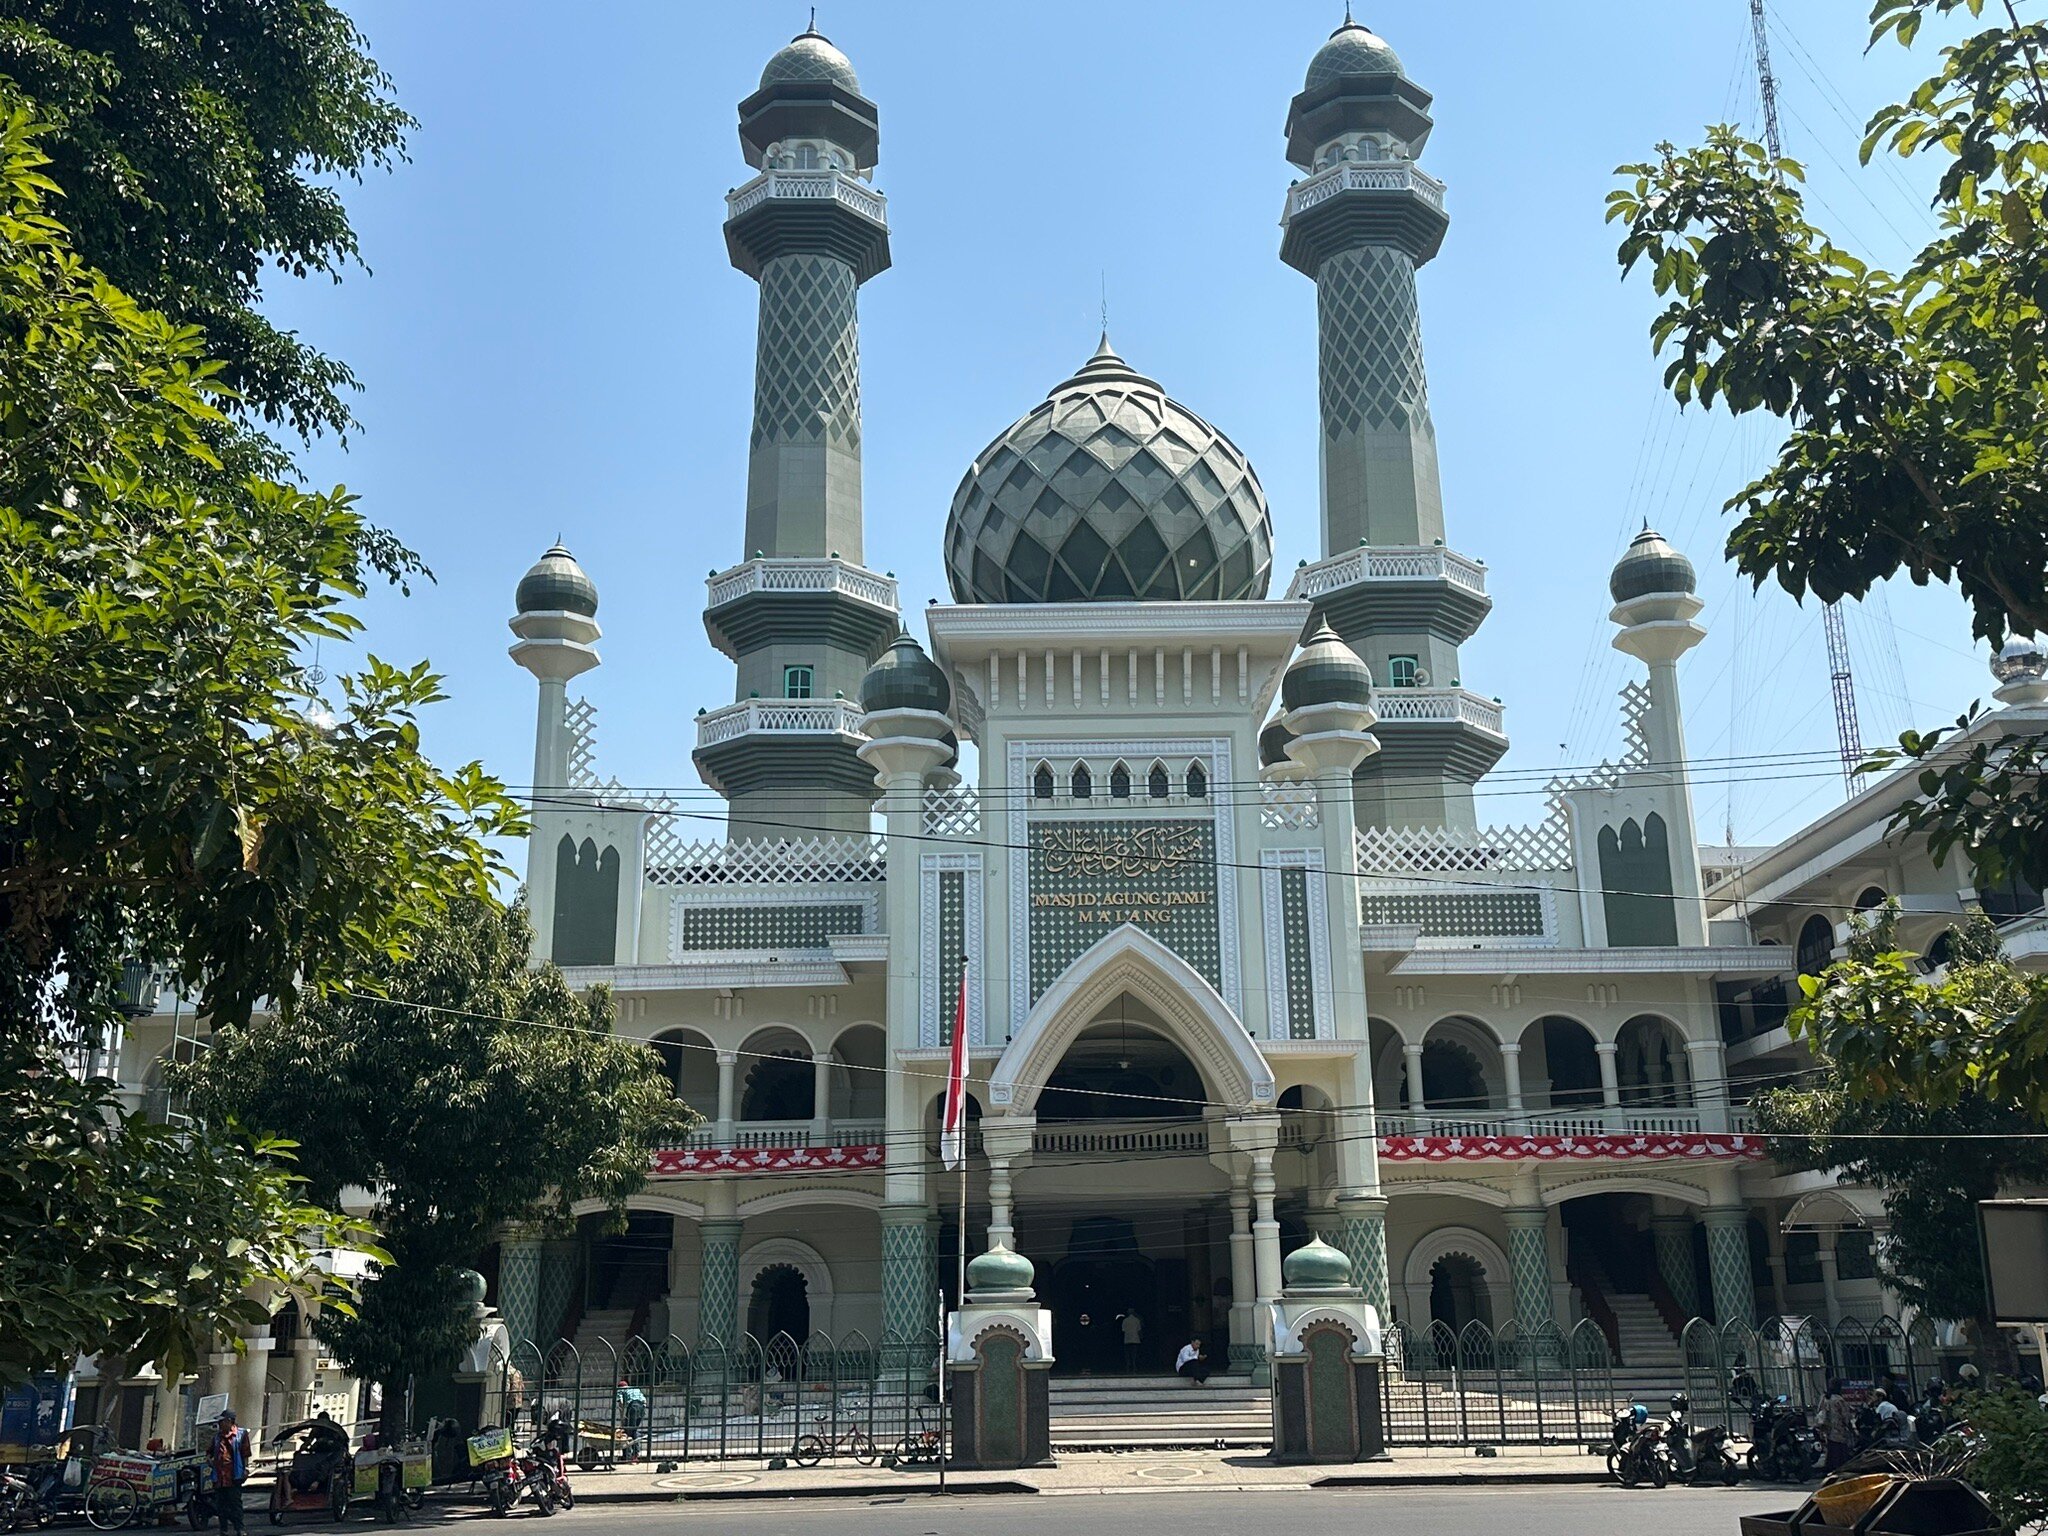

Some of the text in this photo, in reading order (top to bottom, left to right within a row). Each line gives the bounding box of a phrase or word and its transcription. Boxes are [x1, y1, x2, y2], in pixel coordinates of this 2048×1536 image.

[1035, 893, 1096, 907] MASJID
[1102, 892, 1161, 905] AGUNG
[1078, 910, 1171, 923] MALANG
